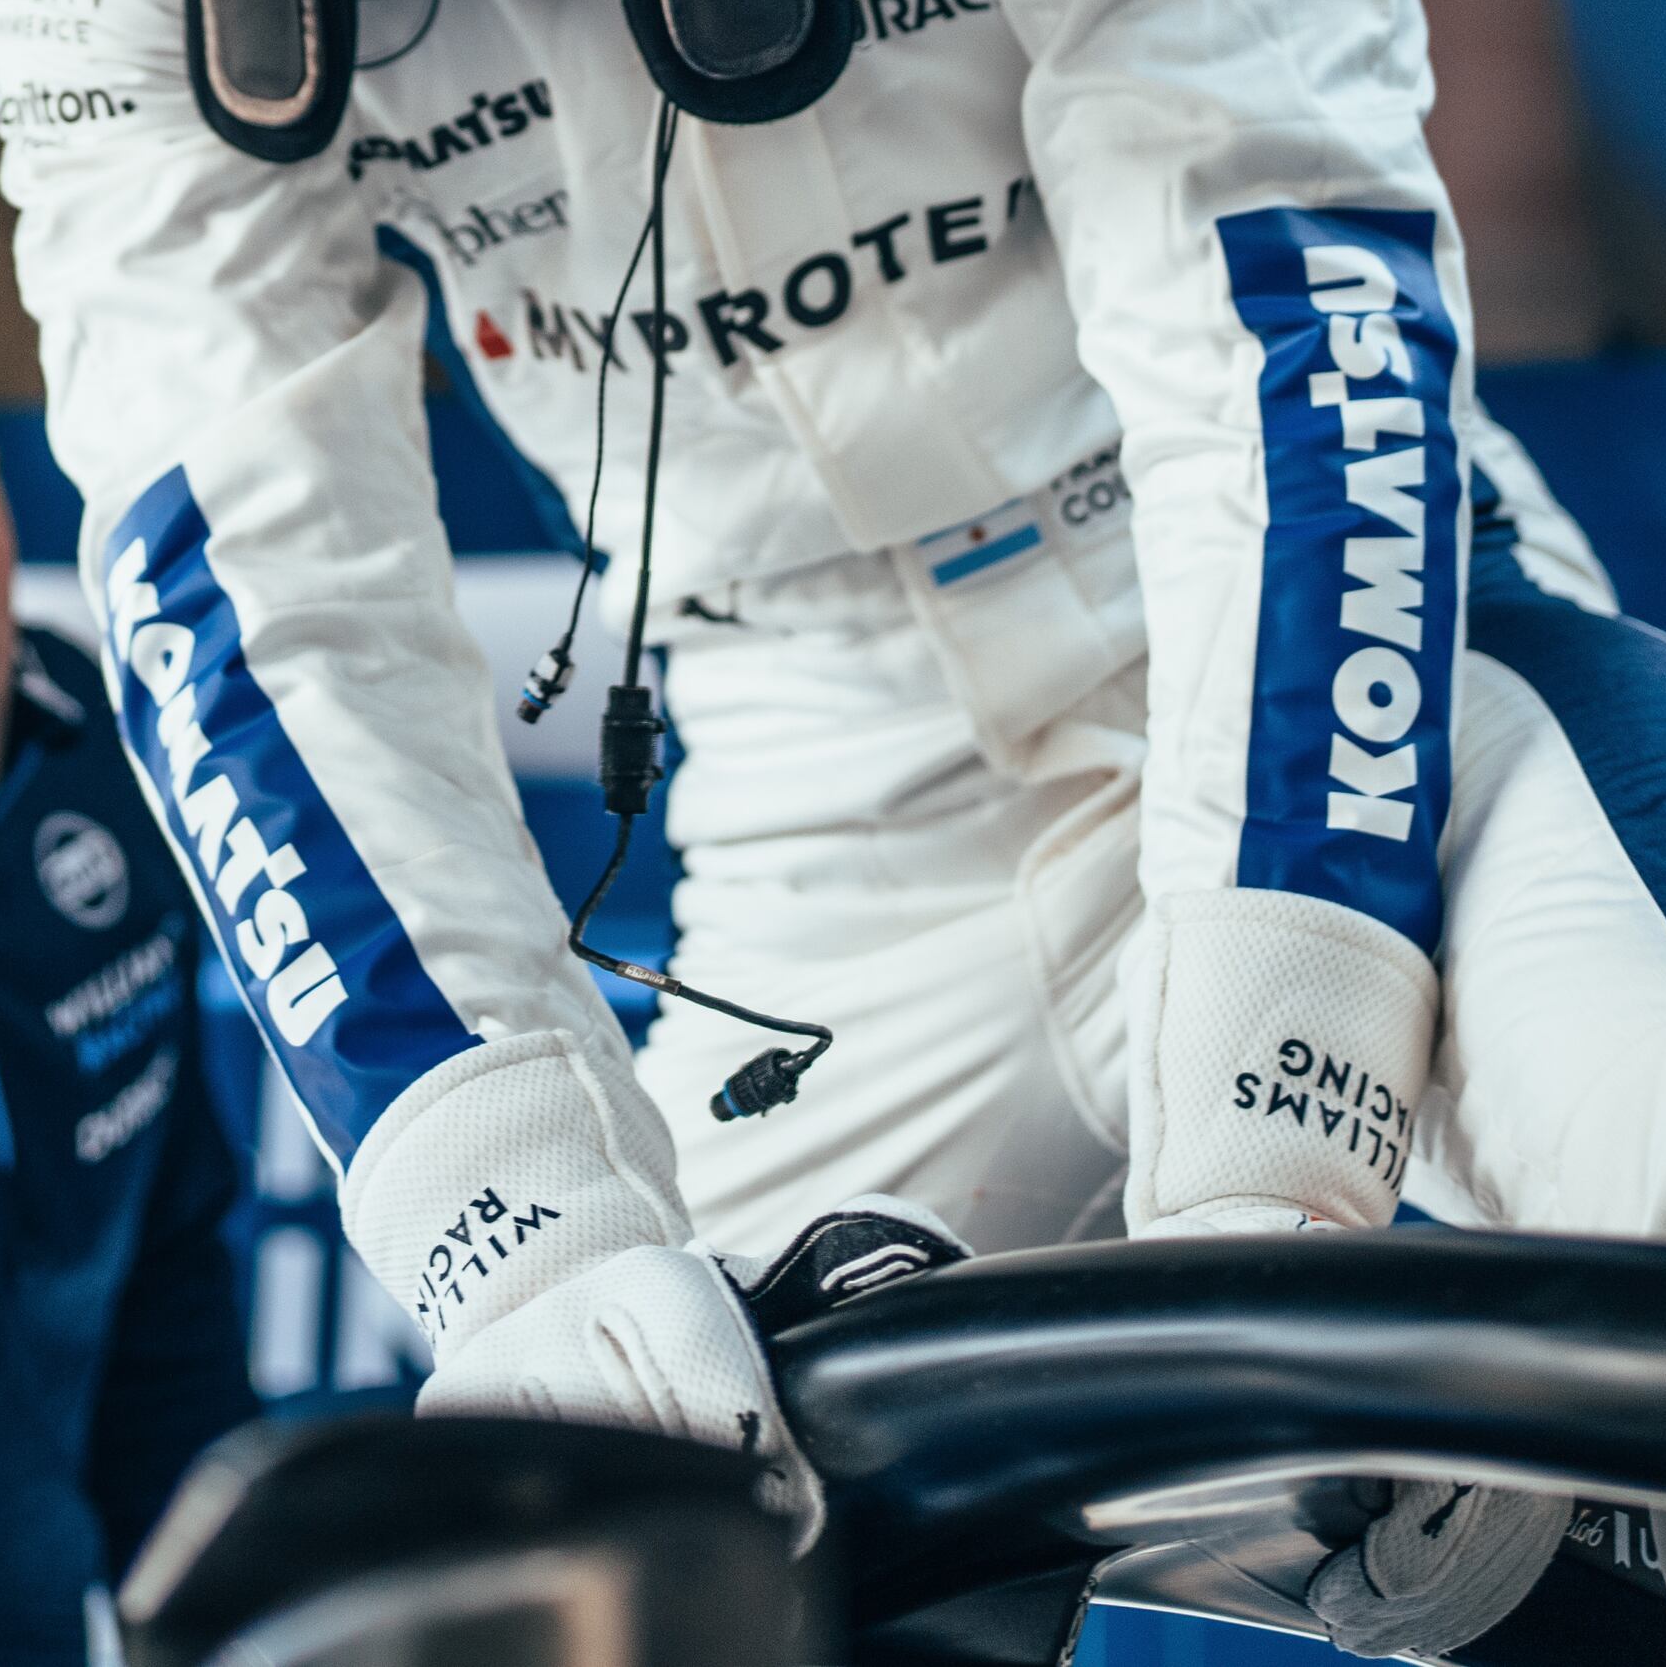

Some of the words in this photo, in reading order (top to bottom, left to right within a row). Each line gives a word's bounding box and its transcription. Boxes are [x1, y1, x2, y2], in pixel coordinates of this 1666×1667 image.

[1304, 245, 1428, 841] KOMATSU
[107, 537, 349, 1048] KOMATSU
[1233, 1072, 1407, 1197] ILLIAMS
[1278, 1038, 1408, 1138] ACING
[416, 1186, 508, 1330] RACIN
[437, 1203, 562, 1332] WILLI
